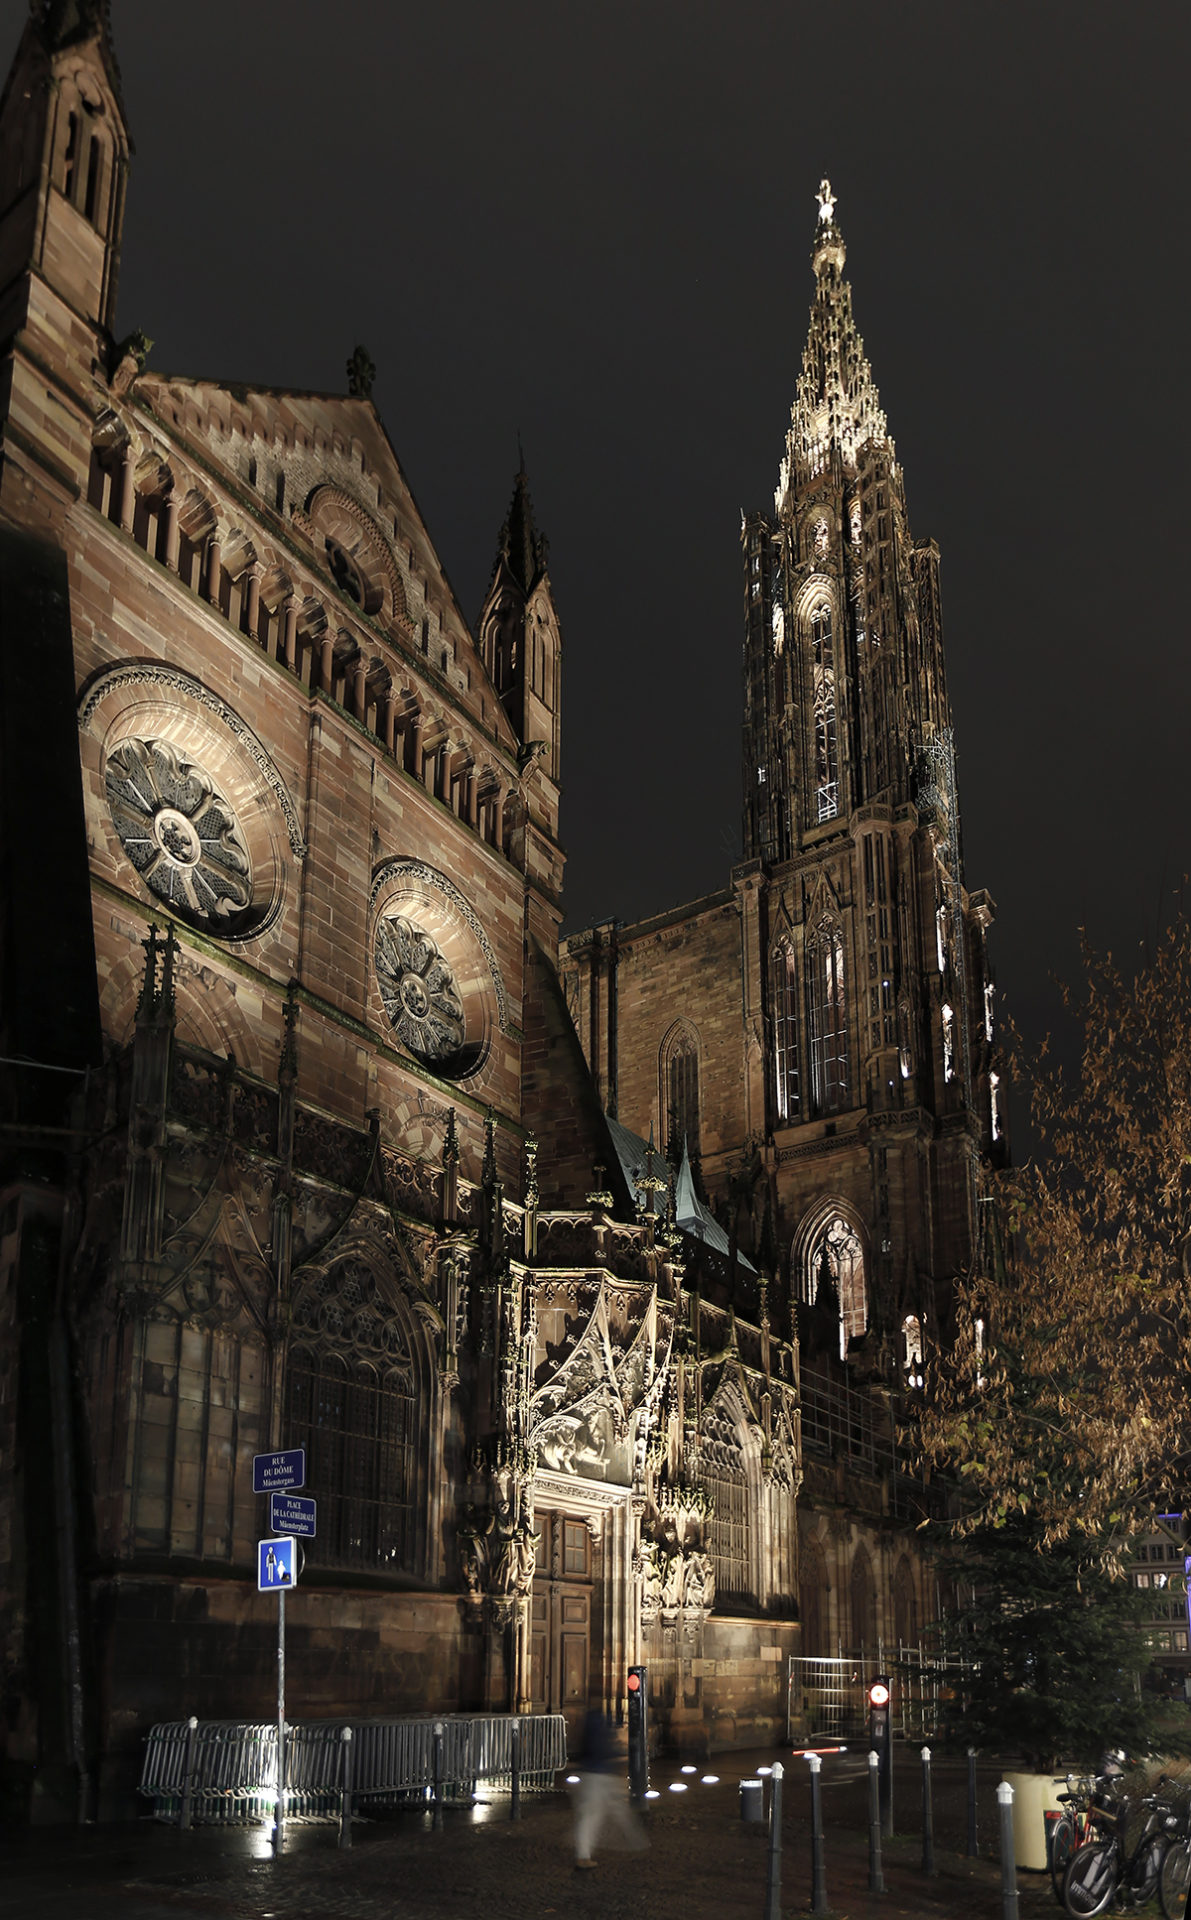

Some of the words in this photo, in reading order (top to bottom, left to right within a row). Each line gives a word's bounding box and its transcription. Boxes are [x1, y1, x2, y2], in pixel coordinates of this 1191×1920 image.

[272, 1456, 285, 1465] RUE
[274, 1465, 293, 1475] DÔME
[287, 1500, 301, 1509] PLACE
[274, 1508, 279, 1516] DE
[280, 1509, 286, 1517] LA
[287, 1511, 313, 1521] CATHÉDRALE
